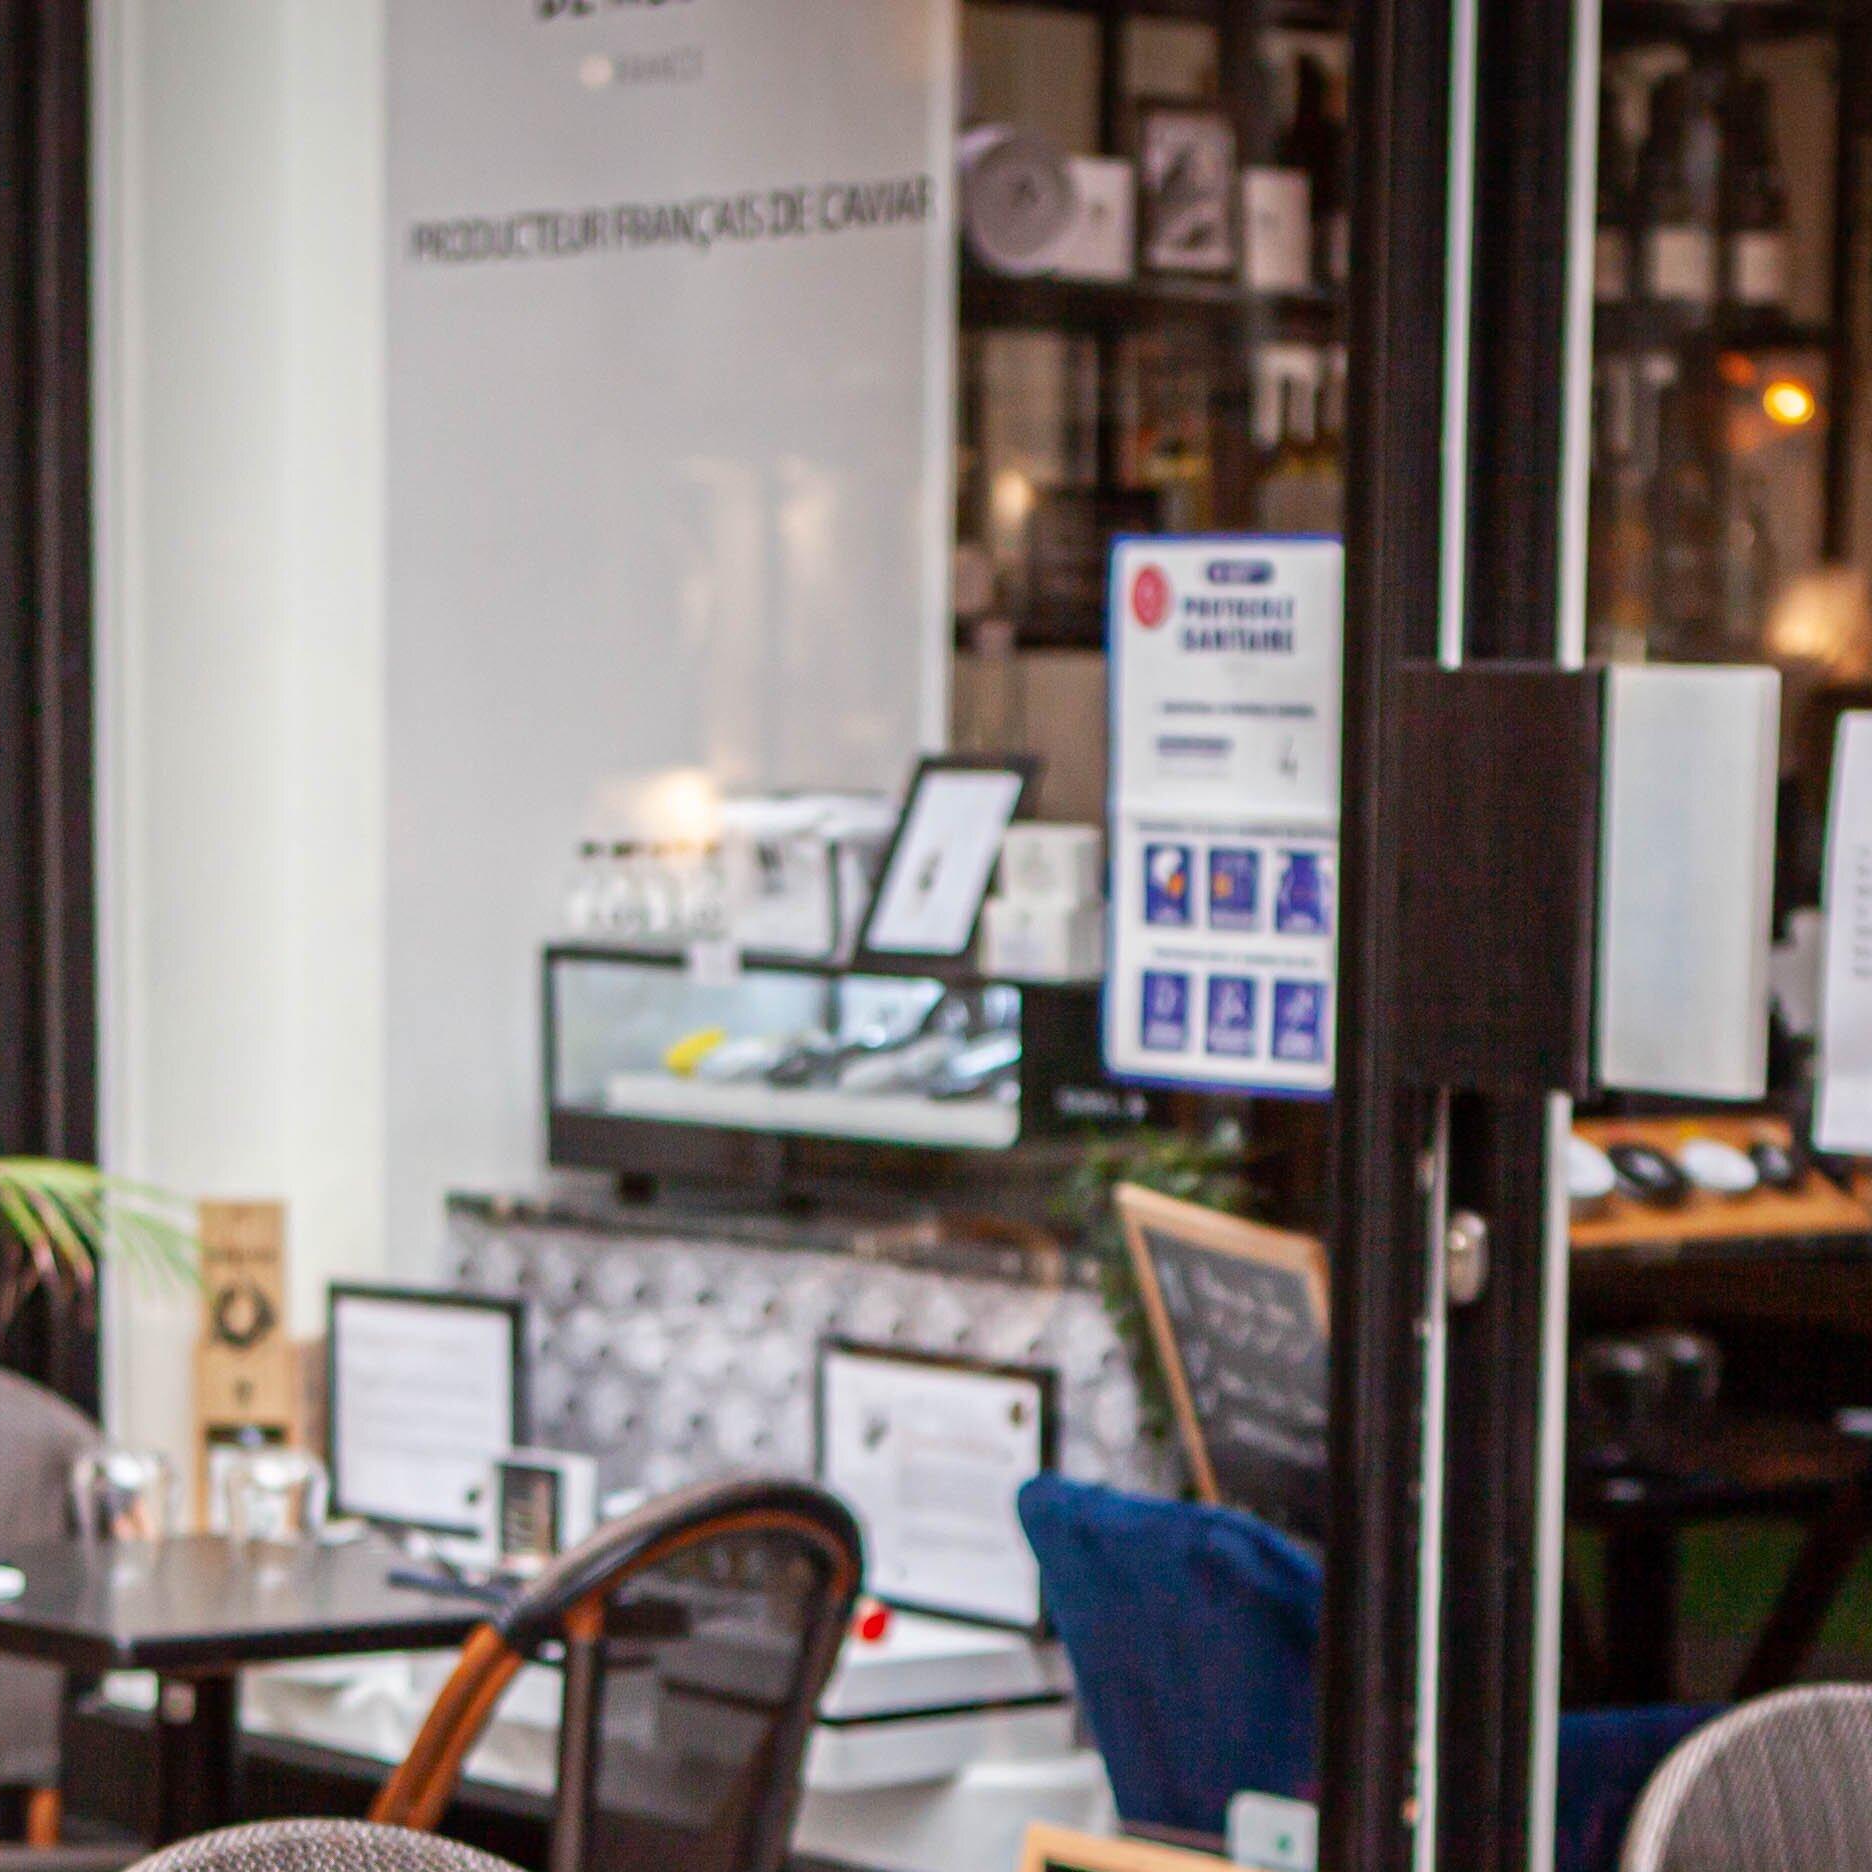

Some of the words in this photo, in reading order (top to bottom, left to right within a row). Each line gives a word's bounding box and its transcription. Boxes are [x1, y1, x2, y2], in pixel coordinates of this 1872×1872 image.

[411, 205, 605, 262] PRODUCTEUR
[613, 190, 764, 251] FRANÇAIS
[769, 187, 808, 235] DE
[820, 174, 934, 232] CAVIAR
